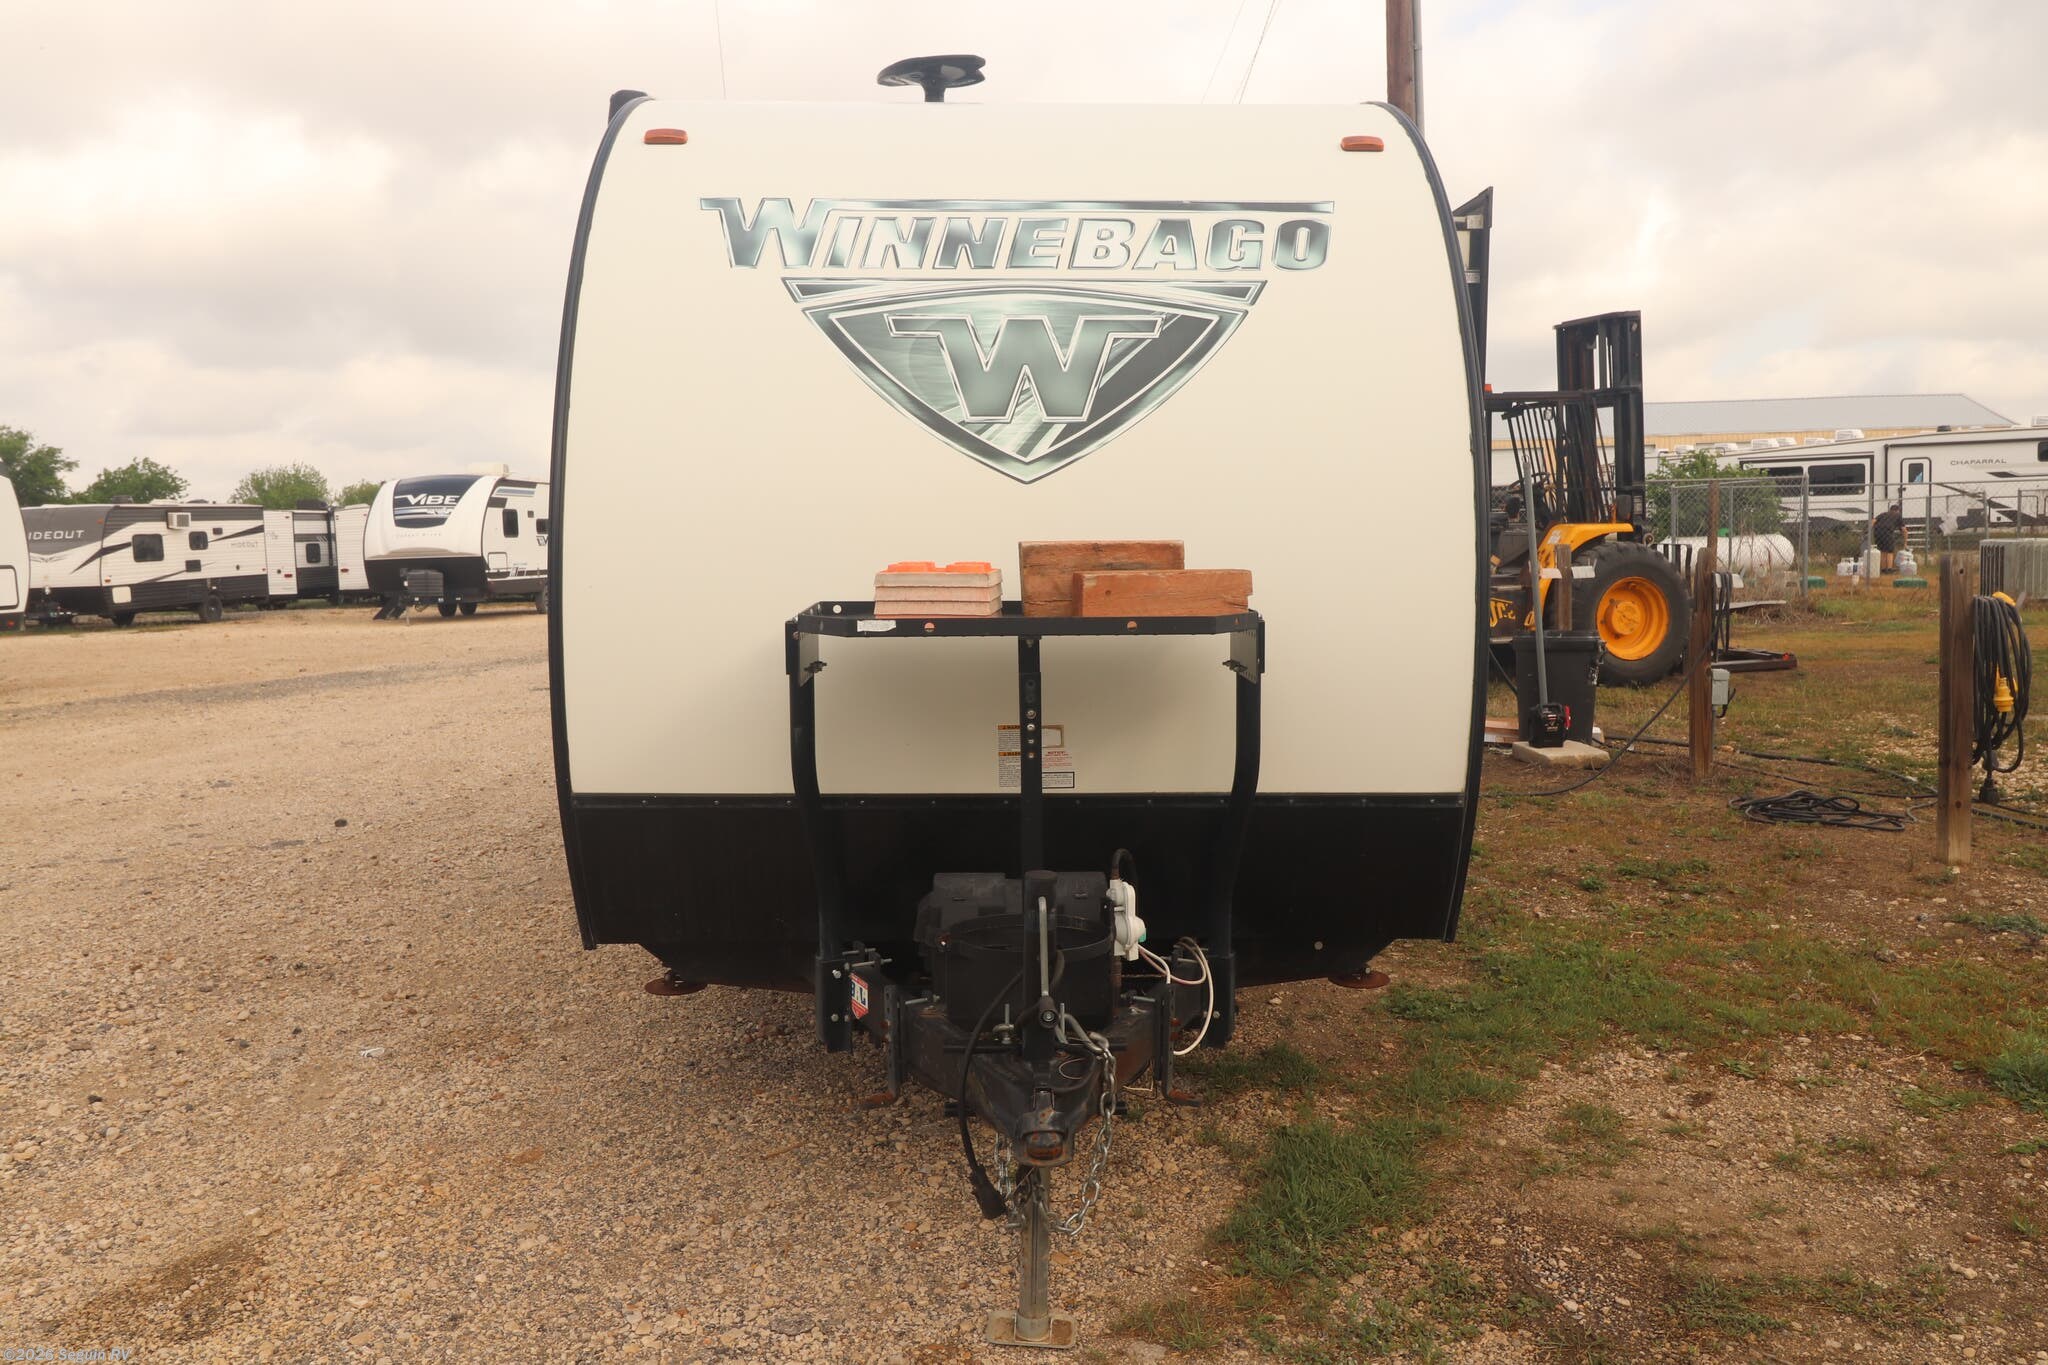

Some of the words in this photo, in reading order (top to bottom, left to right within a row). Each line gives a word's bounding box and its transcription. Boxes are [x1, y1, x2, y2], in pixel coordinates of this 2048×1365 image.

[699, 197, 1335, 271] WINNEBAGO
[1950, 458, 2007, 466] CHAPARRAL
[394, 493, 461, 506] VIBE
[28, 529, 85, 541] IDEOUT
